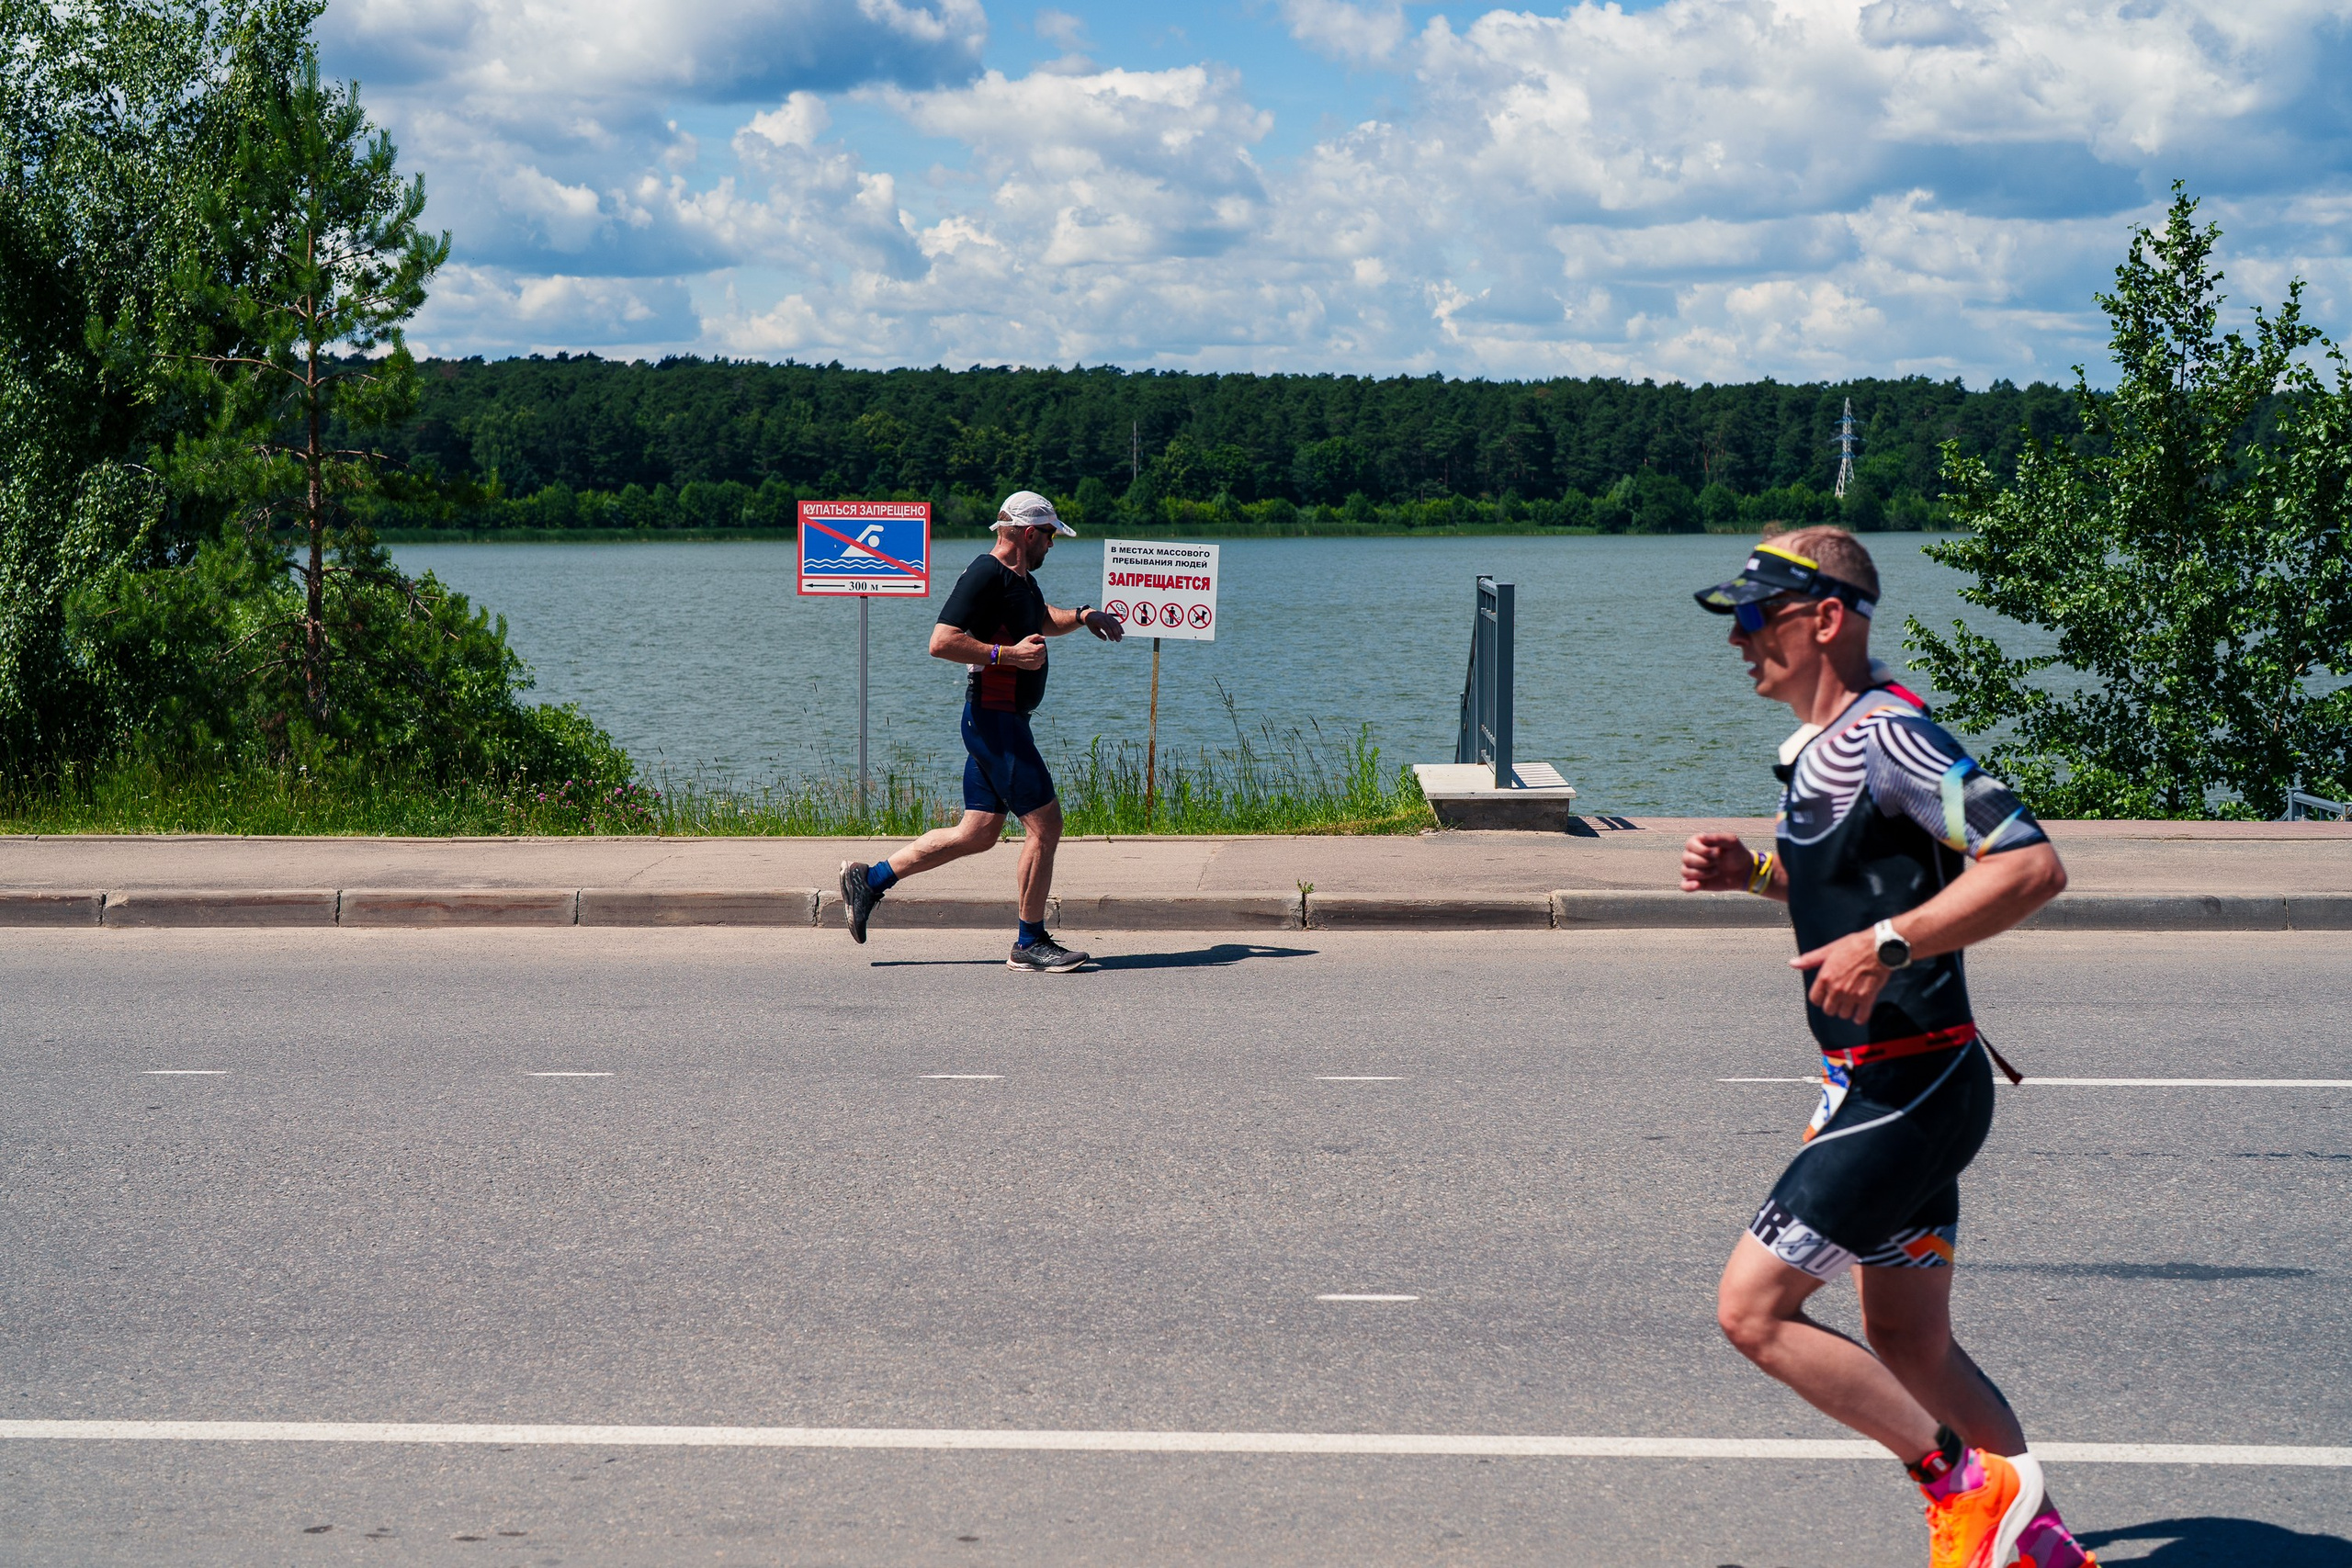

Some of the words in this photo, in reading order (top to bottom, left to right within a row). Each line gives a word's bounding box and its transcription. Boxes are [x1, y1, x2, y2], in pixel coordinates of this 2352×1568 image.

[803, 504, 857, 515] КУПАТЬСЯ
[859, 505, 926, 517] ЗАПРЕЩЕНО
[1119, 547, 1154, 555] МЕСТАХ
[1156, 549, 1210, 558] МАССОВОГО
[1113, 558, 1172, 566] ПРЕБЫВАНИЯ
[1175, 560, 1207, 569] ЛЮДЕЙ
[848, 581, 867, 592] 300
[1108, 572, 1210, 591] ЗАПРЕЩАЕТСЯ
